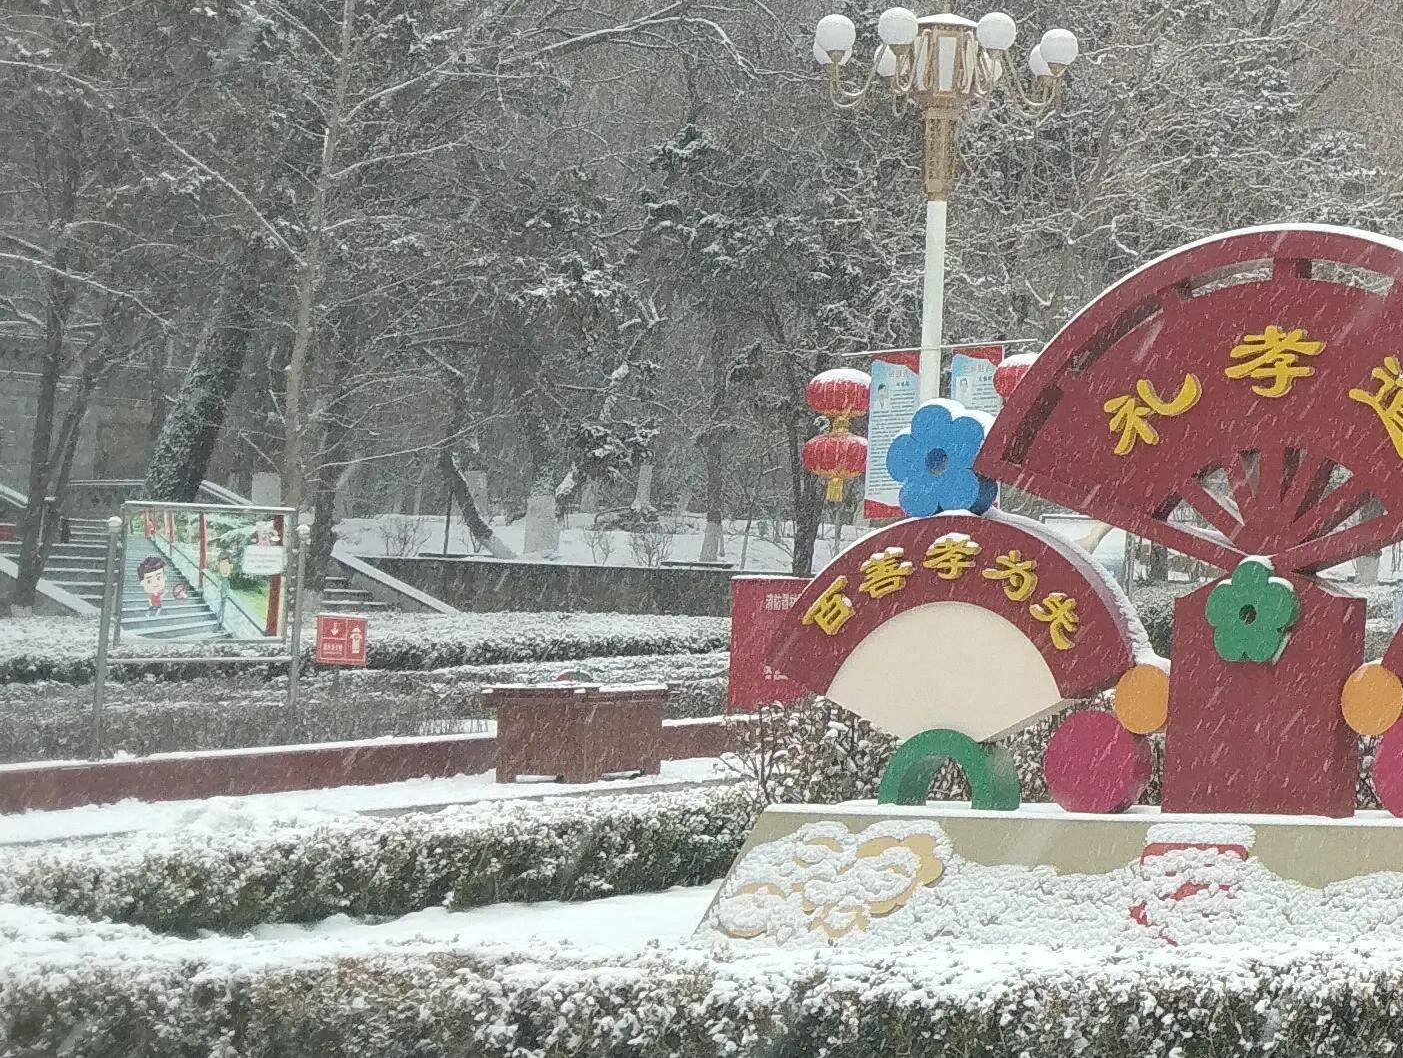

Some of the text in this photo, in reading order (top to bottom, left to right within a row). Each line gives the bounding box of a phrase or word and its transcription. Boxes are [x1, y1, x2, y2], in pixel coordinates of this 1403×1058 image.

[802, 532, 1080, 650] 百善孝为先
